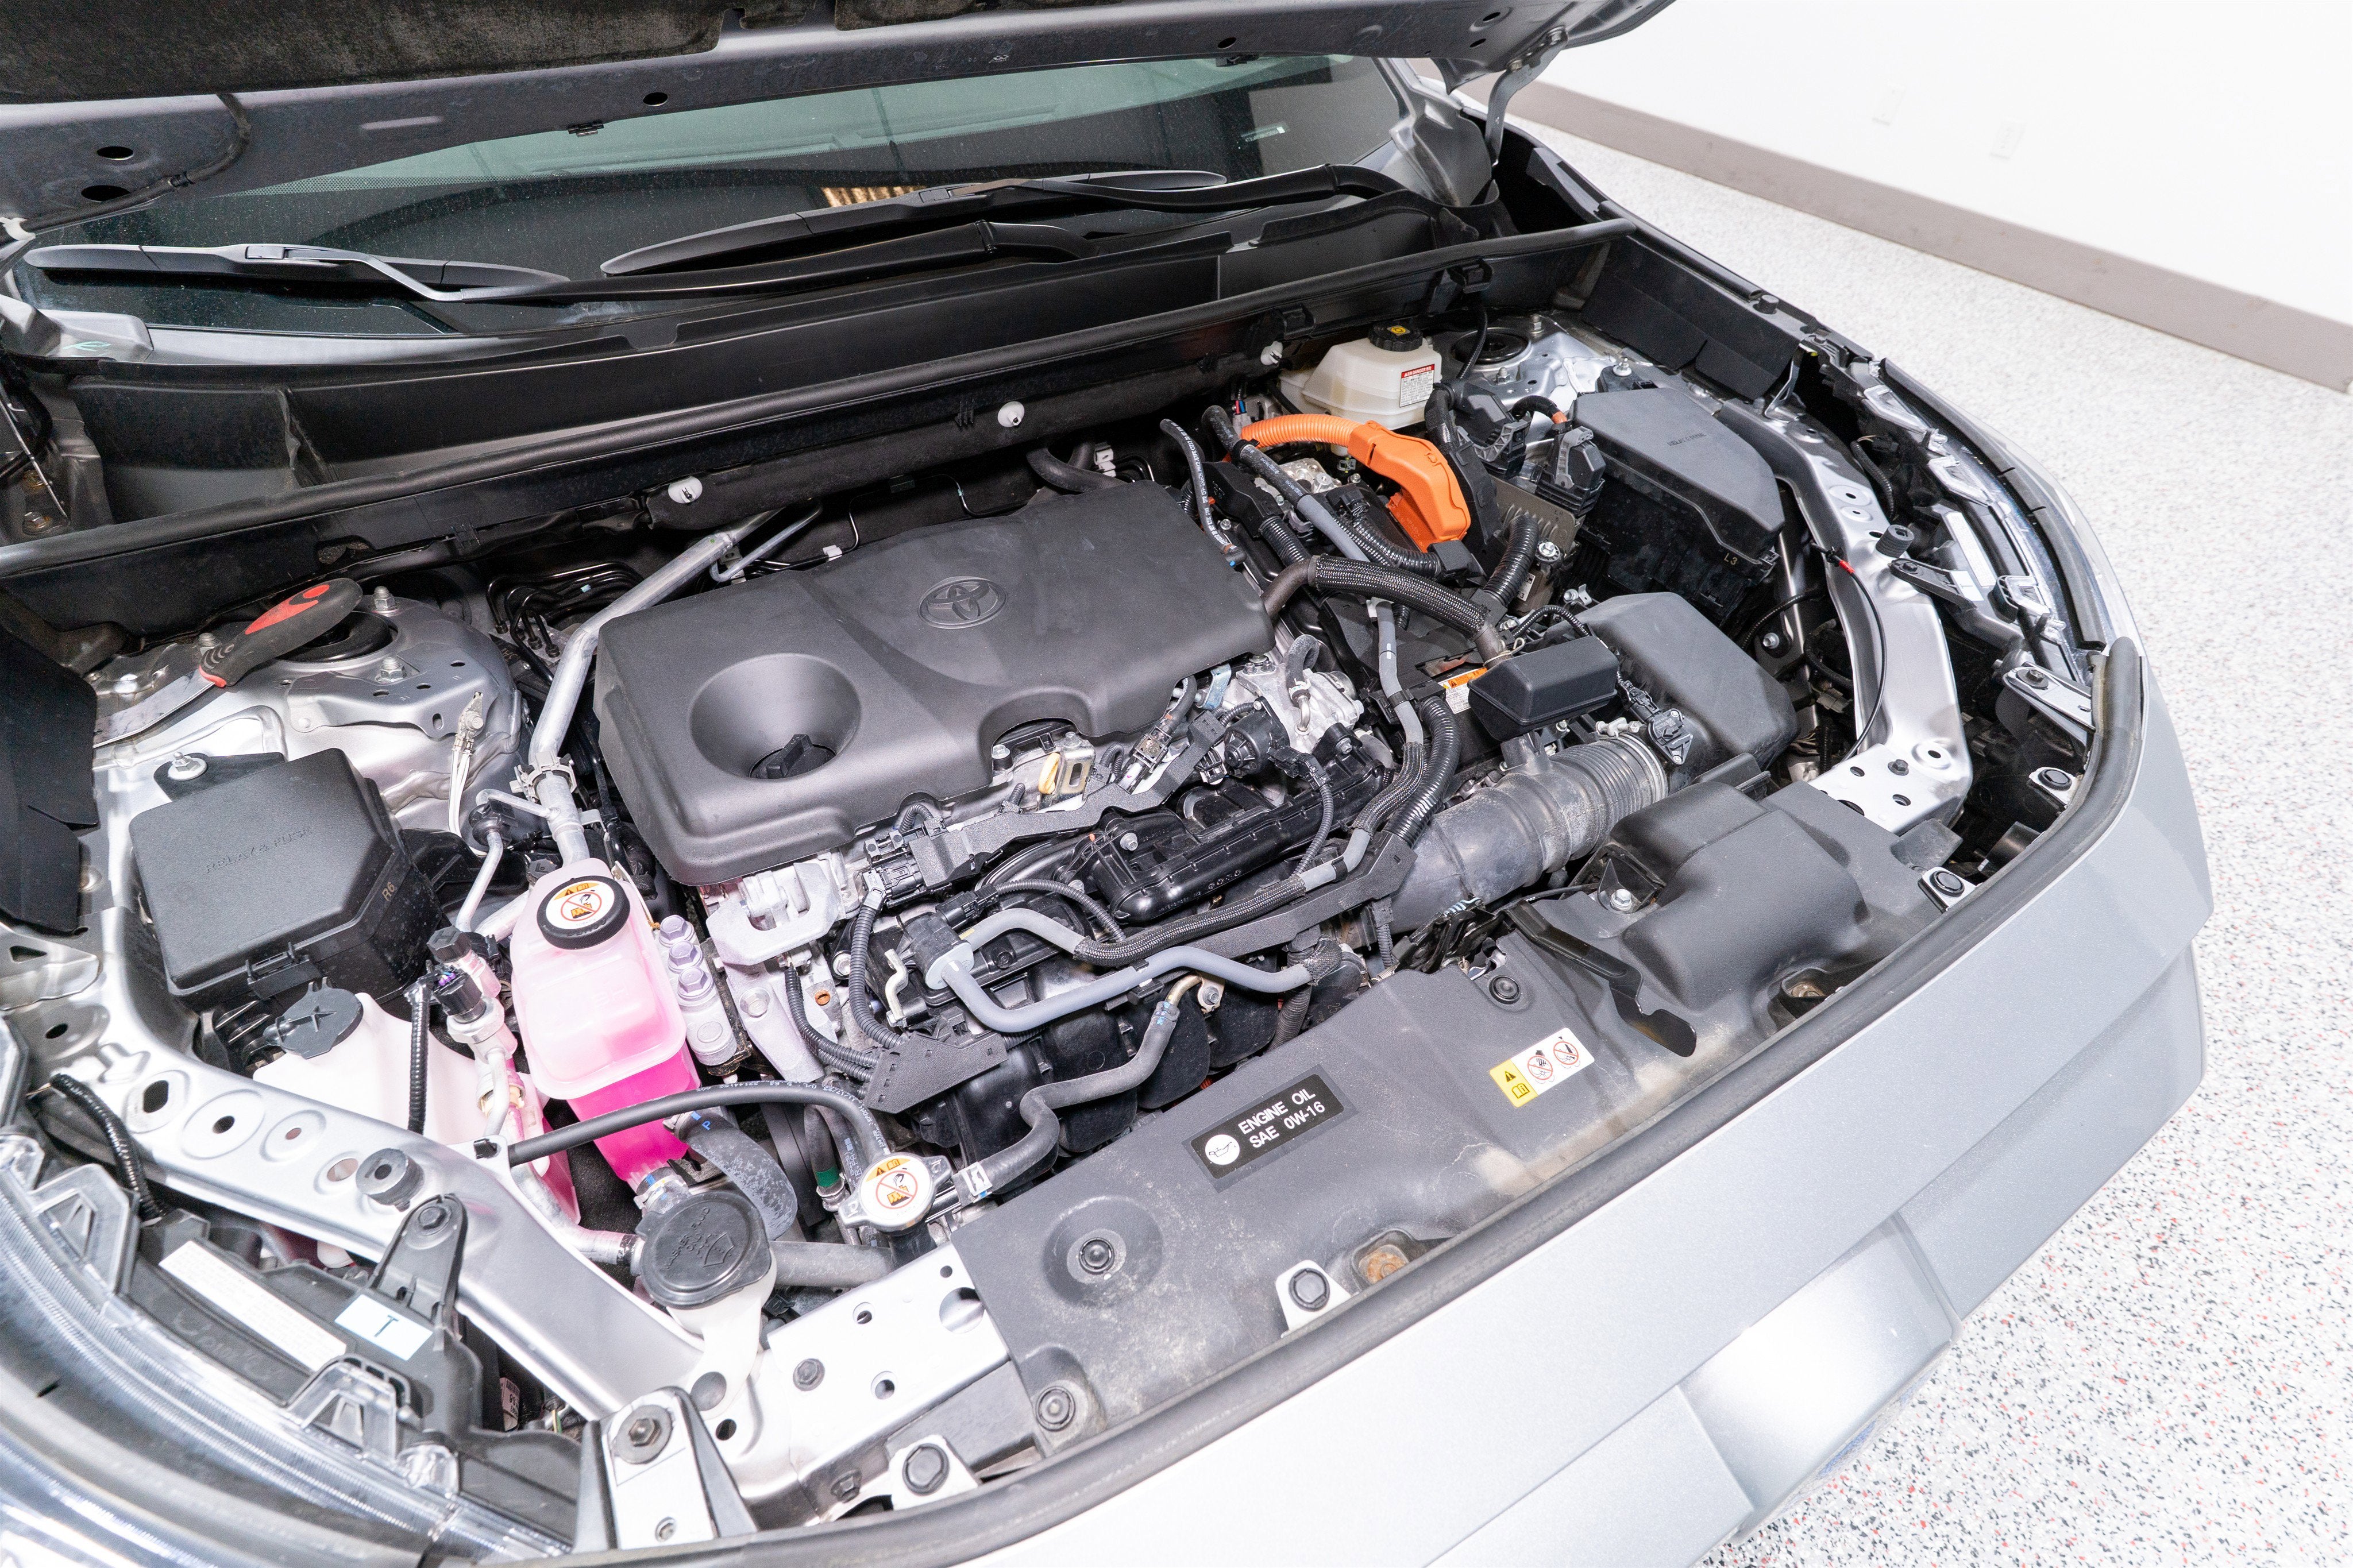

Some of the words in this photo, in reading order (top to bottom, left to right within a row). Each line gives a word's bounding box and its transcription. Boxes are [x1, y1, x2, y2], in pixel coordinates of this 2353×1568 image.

[1724, 553, 1738, 565] L3
[206, 847, 255, 874] RELAY
[273, 826, 313, 847] FUSE
[381, 882, 395, 901] R6
[1238, 1101, 1289, 1134] ENGINE
[1291, 1089, 1316, 1105] OIL
[702, 1120, 711, 1130] P
[1249, 1125, 1280, 1148] SAE
[1283, 1101, 1325, 1129] 0W-16
[691, 1207, 711, 1231] FLUID
[373, 1314, 399, 1338] T
